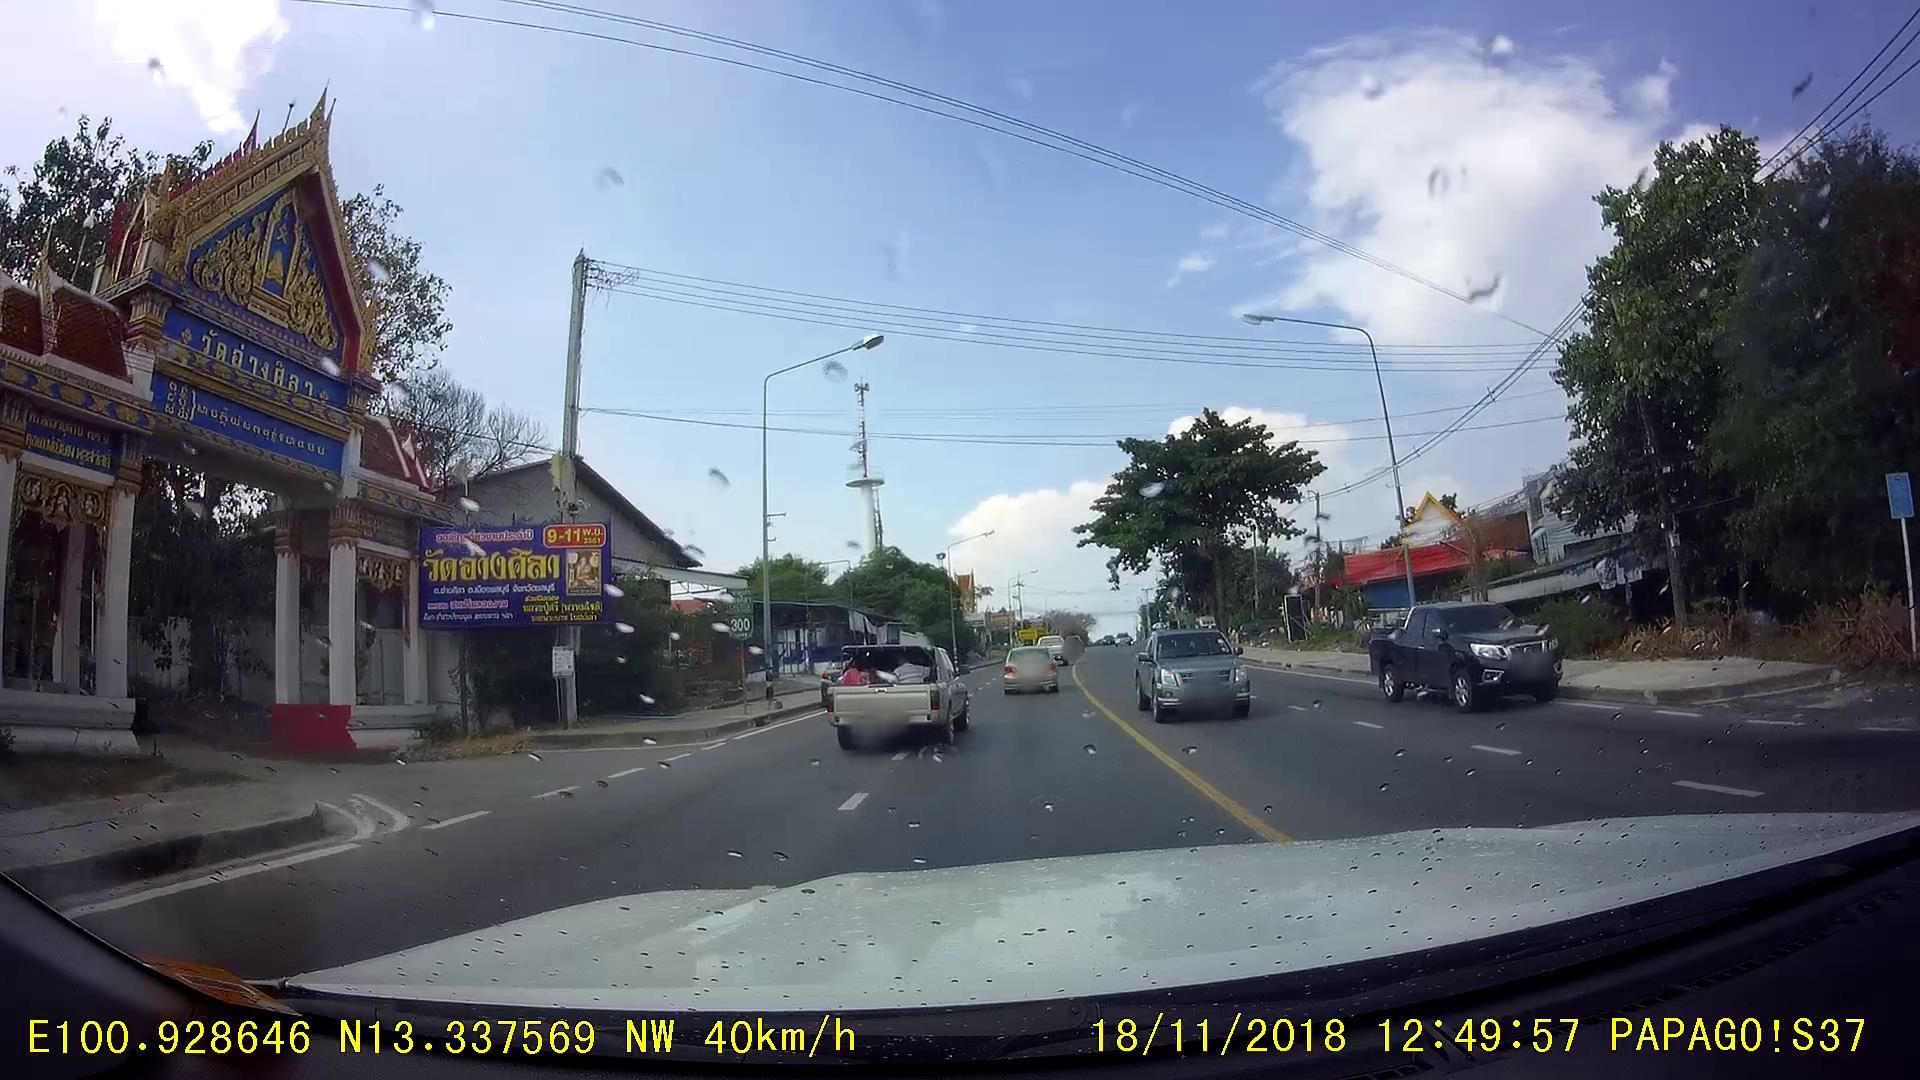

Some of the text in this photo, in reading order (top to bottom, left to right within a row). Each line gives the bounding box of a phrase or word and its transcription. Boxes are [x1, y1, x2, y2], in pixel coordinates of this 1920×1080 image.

[201, 329, 314, 397] วัดอ่างศิลา
[548, 527, 581, 544] 9-11
[730, 618, 751, 632] 300
